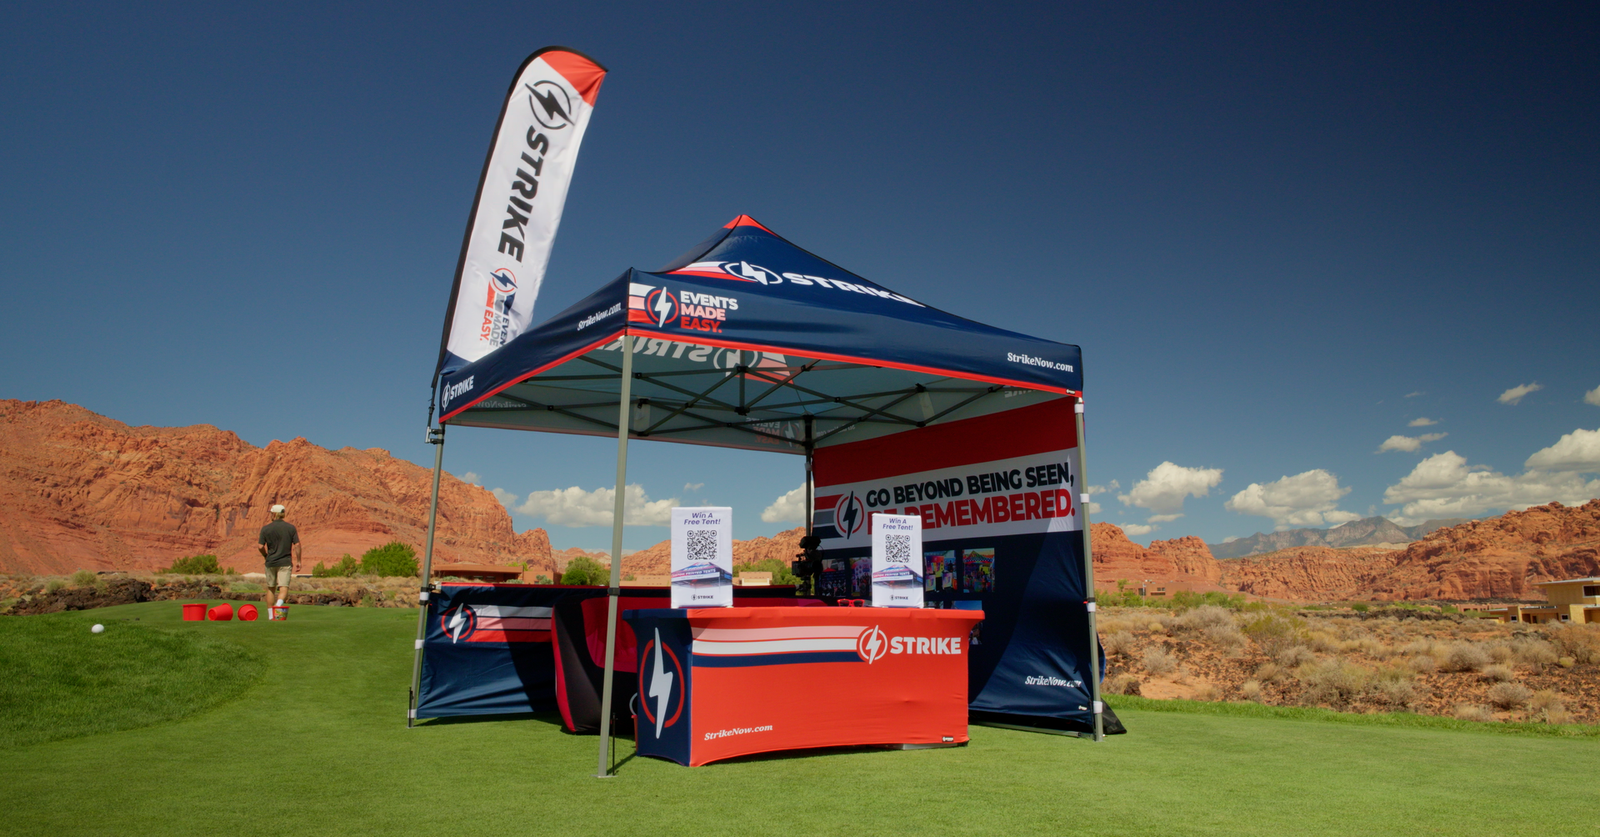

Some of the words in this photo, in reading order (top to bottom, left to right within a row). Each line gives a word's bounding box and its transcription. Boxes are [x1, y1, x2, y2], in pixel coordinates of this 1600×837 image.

[498, 125, 549, 263] STRIKE
[680, 290, 739, 310] EVENTS
[681, 303, 726, 321] MADE
[479, 309, 494, 341] EASY.
[577, 302, 621, 331] StrikeNow.com
[680, 316, 723, 333] EASY.
[489, 312, 501, 347] MADE
[500, 317, 509, 345] EVEN
[1007, 352, 1074, 373] StrikeNow.com
[450, 375, 475, 400] STRIKE
[866, 488, 891, 508] GO
[893, 477, 964, 504] BEYOND
[966, 469, 1022, 494] BEING
[1025, 462, 1075, 488] SEEN,
[890, 636, 962, 655] STRIKE
[704, 725, 773, 741] StrikeNow.com
